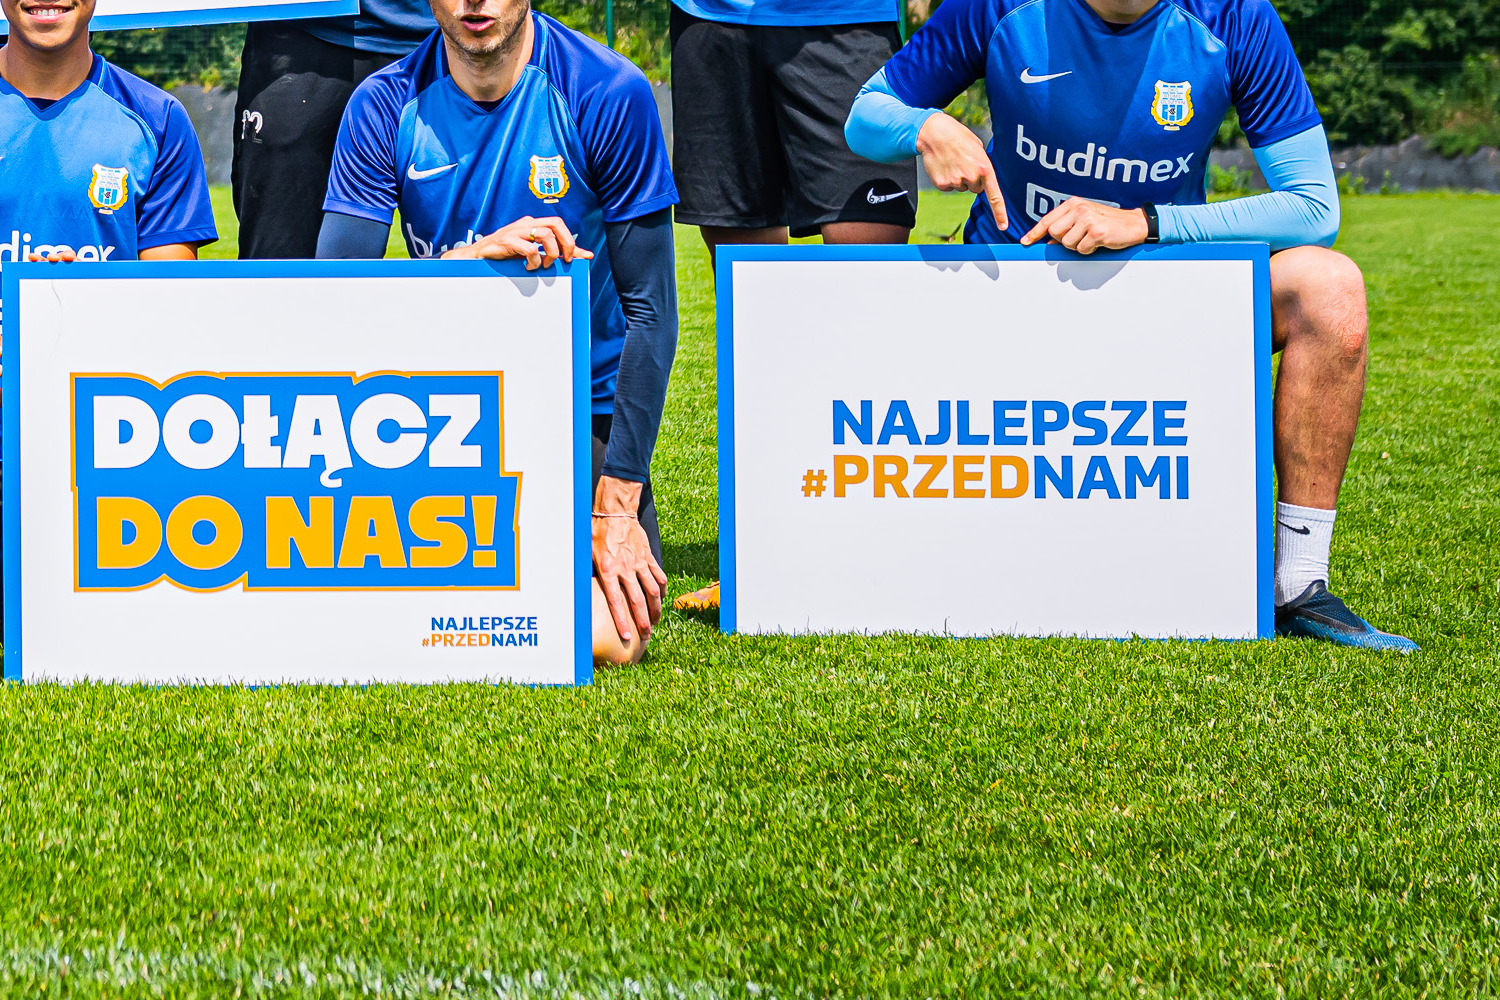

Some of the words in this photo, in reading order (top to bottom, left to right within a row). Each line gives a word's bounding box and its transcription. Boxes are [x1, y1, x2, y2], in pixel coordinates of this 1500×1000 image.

[1016, 124, 1194, 183] budimex
[93, 393, 482, 488] DOŁĄCZ
[832, 400, 1189, 446] NAJLEPSZE
[801, 454, 1189, 499] #PRZEDNAMI
[97, 495, 243, 570] DO
[265, 495, 497, 568] NAS!
[422, 633, 538, 647] #PRZEDNAMI
[431, 616, 538, 631] NAJLEPSZE
